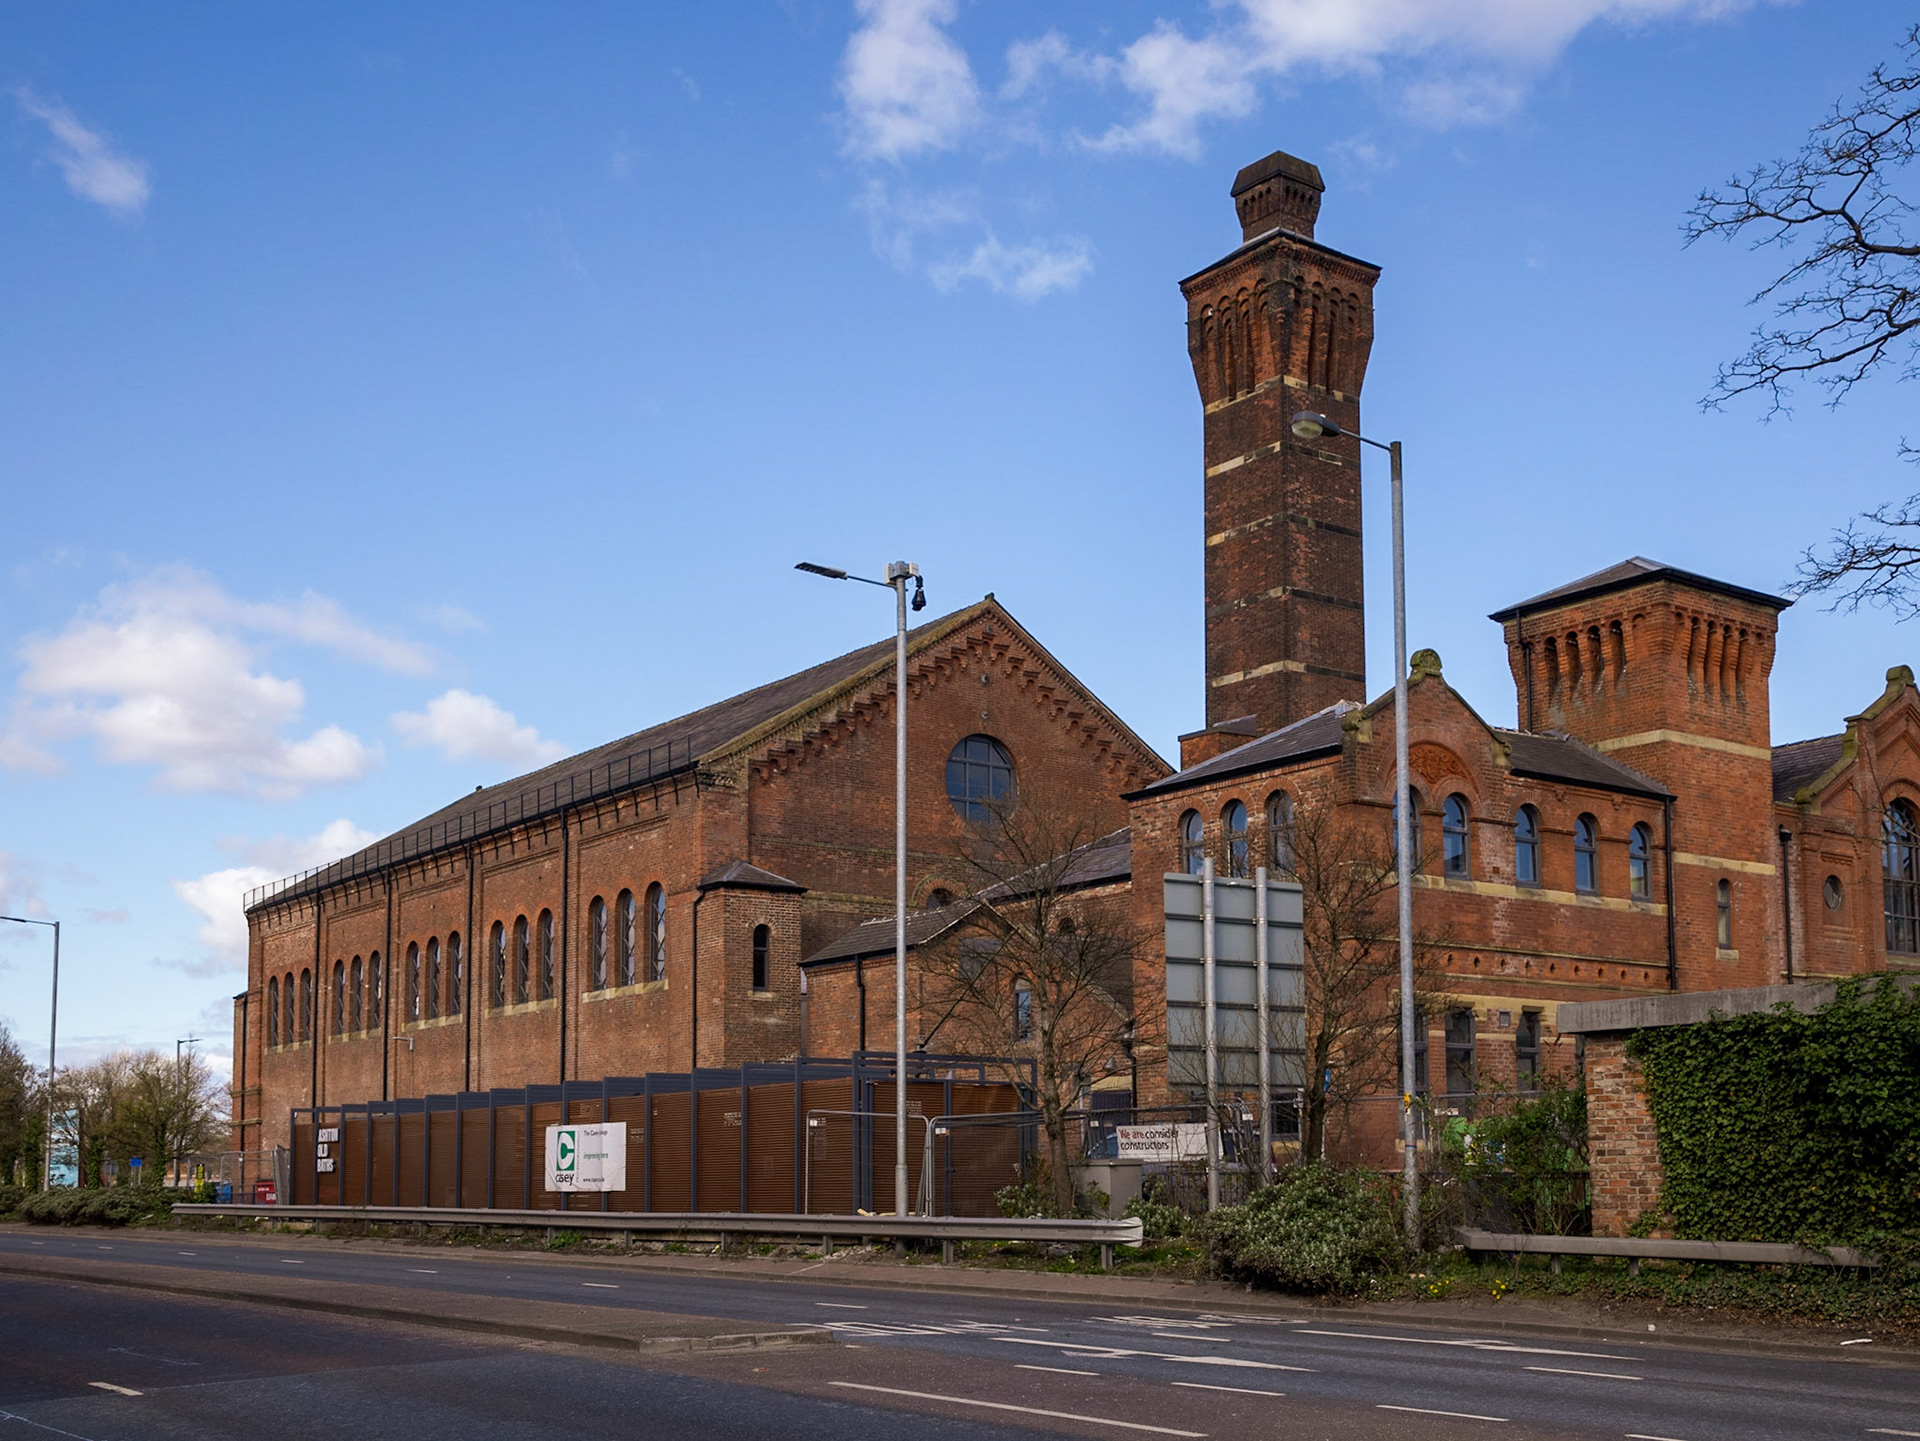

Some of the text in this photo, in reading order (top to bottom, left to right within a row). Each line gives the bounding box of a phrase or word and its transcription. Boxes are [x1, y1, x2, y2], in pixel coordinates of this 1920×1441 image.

[318, 1128, 339, 1142] ASHTON
[1119, 1129, 1130, 1139] We
[1132, 1131, 1144, 1139] are
[317, 1144, 328, 1157] OLD
[1120, 1141, 1169, 1150] constructors
[317, 1158, 333, 1172] BATHS
[555, 1173, 575, 1186] casey
